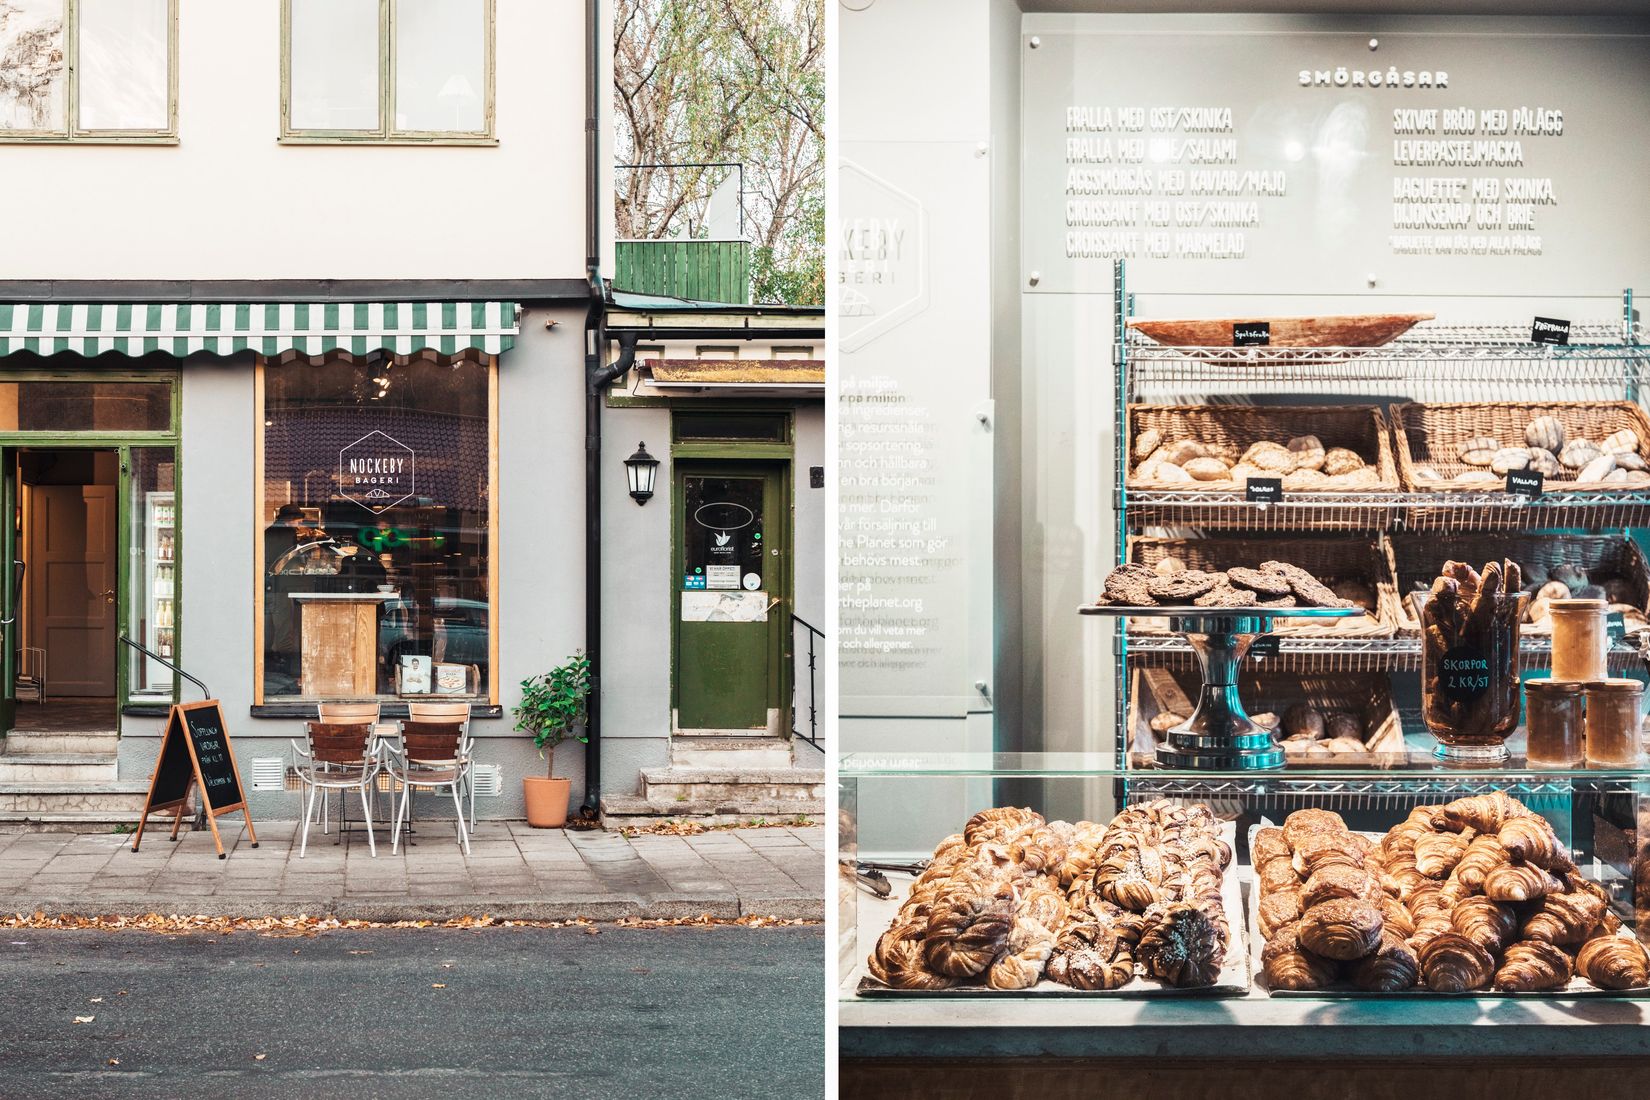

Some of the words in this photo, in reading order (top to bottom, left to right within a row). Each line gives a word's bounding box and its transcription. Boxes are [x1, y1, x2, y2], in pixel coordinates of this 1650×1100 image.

[1298, 66, 1449, 85] SMÖRGÅSAR
[1066, 106, 1112, 129] FRALLA
[1118, 106, 1144, 129] MED
[1150, 106, 1233, 130] OST/SKINKA
[1393, 108, 1439, 130] SKIVAT
[1442, 106, 1476, 130] BRÖD
[1480, 108, 1508, 130] MED
[1512, 105, 1564, 131] PÅLÄGG
[1066, 138, 1112, 160] FRALLA
[1118, 138, 1144, 160] MED
[1149, 138, 1237, 160] E/SALAMI
[1393, 139, 1524, 162] LEVERPASTEJMACKA
[1158, 169, 1185, 192] MED
[1190, 169, 1287, 192] KAVIAR/MAJO
[1472, 178, 1499, 199] MED
[1505, 178, 1557, 201] SKINKA,
[1066, 200, 1138, 222] CROISSANT
[1144, 201, 1170, 222] MED
[1175, 201, 1260, 223] OST/SKINKA
[1393, 203, 1471, 224] DIJONSENAP
[1476, 203, 1501, 225] OCH
[1507, 204, 1535, 225] BRIE
[1066, 231, 1139, 253] CROISSANT
[1144, 232, 1170, 254] MED
[1175, 232, 1245, 254] MARMELAD
[350, 457, 403, 474] NOCKEBY
[854, 455, 877, 469] och
[880, 454, 927, 469] hållbara
[355, 476, 399, 484] BAGERI
[859, 474, 879, 486] bra
[1512, 476, 1539, 487] VALLMO
[859, 516, 920, 536] försäljning
[922, 517, 937, 531] till
[857, 534, 896, 549] Planet
[899, 539, 925, 549] som
[928, 536, 948, 554] gör
[844, 552, 887, 566] behövs
[838, 582, 853, 592] er
[857, 577, 872, 596] på
[854, 623, 867, 636] du
[869, 624, 881, 636] vill
[883, 626, 904, 636] veta
[906, 626, 927, 636] mer
[843, 637, 861, 649] och
[1443, 658, 1489, 671] SKORPOR
[1448, 675, 1456, 689] 2
[1459, 674, 1489, 692] KR/ST
